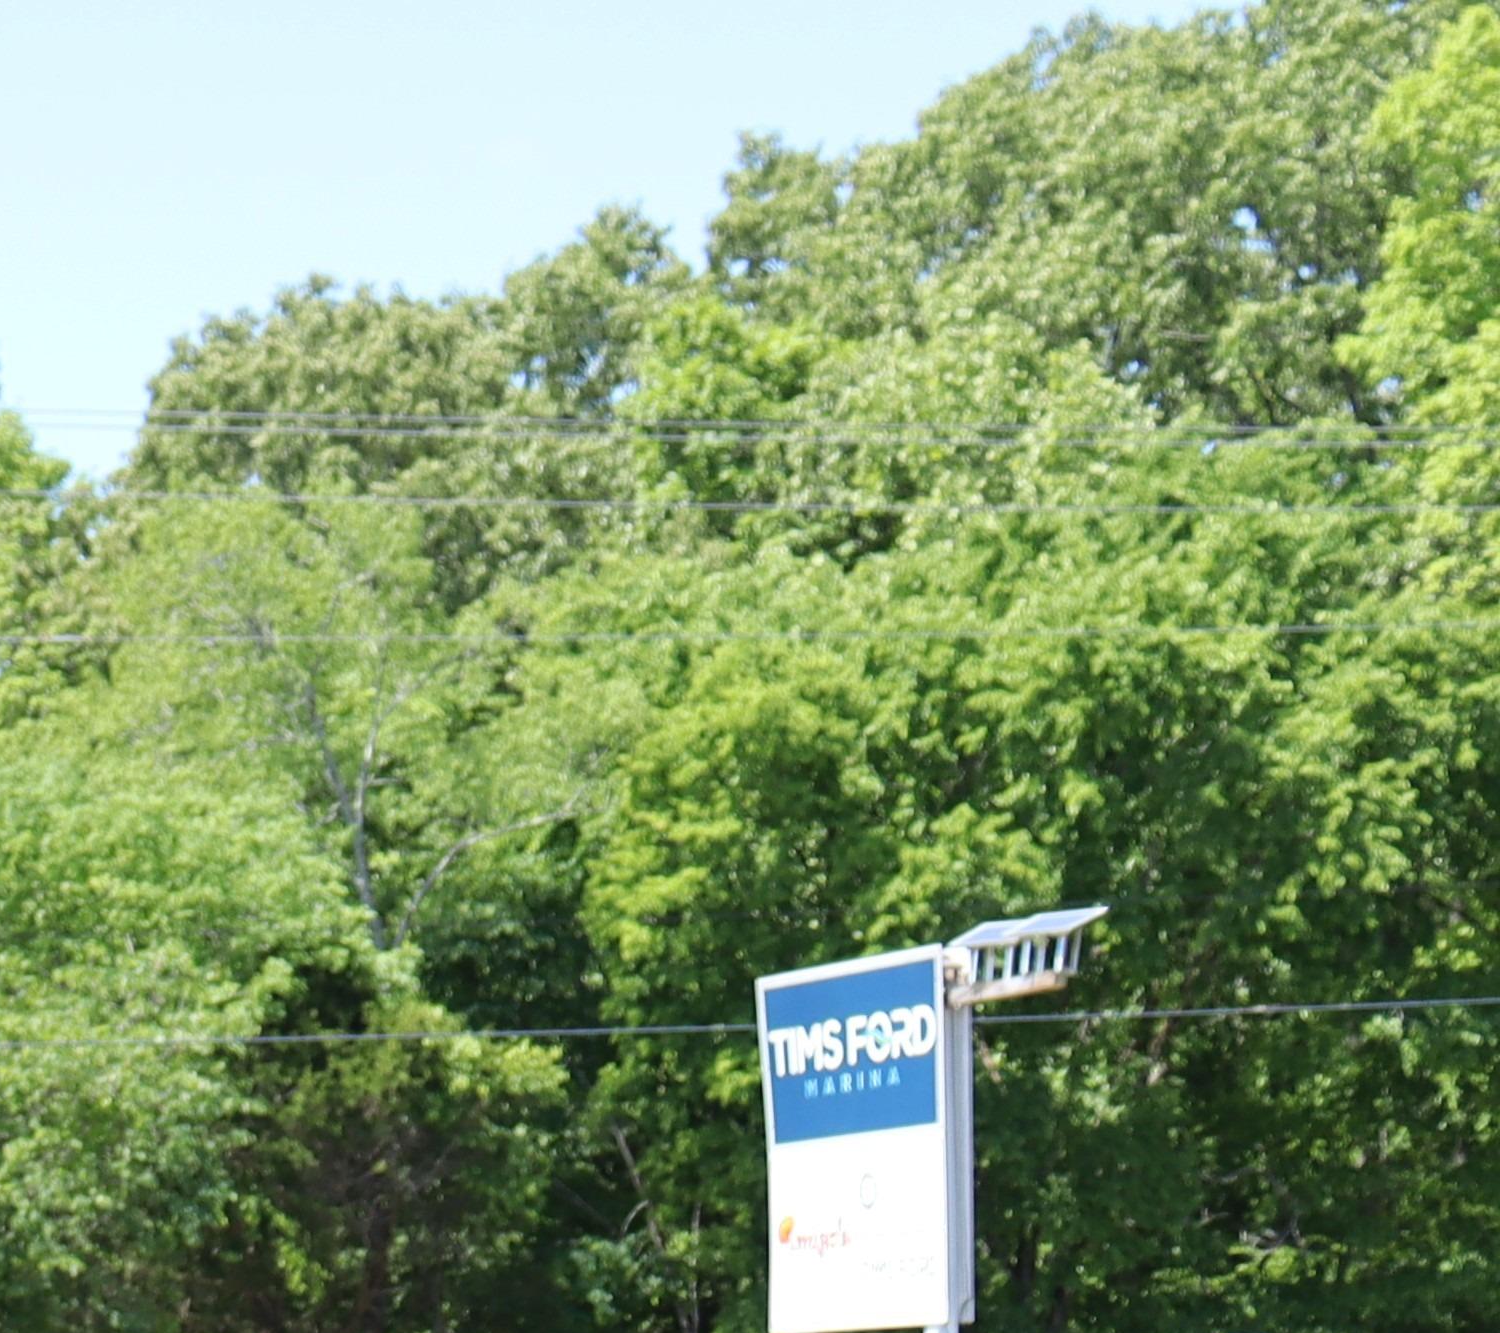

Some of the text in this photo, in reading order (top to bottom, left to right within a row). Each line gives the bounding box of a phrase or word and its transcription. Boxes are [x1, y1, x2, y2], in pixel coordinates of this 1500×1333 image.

[767, 1003, 937, 1078] TIMS FORD
[803, 1065, 901, 1099] MARINA
